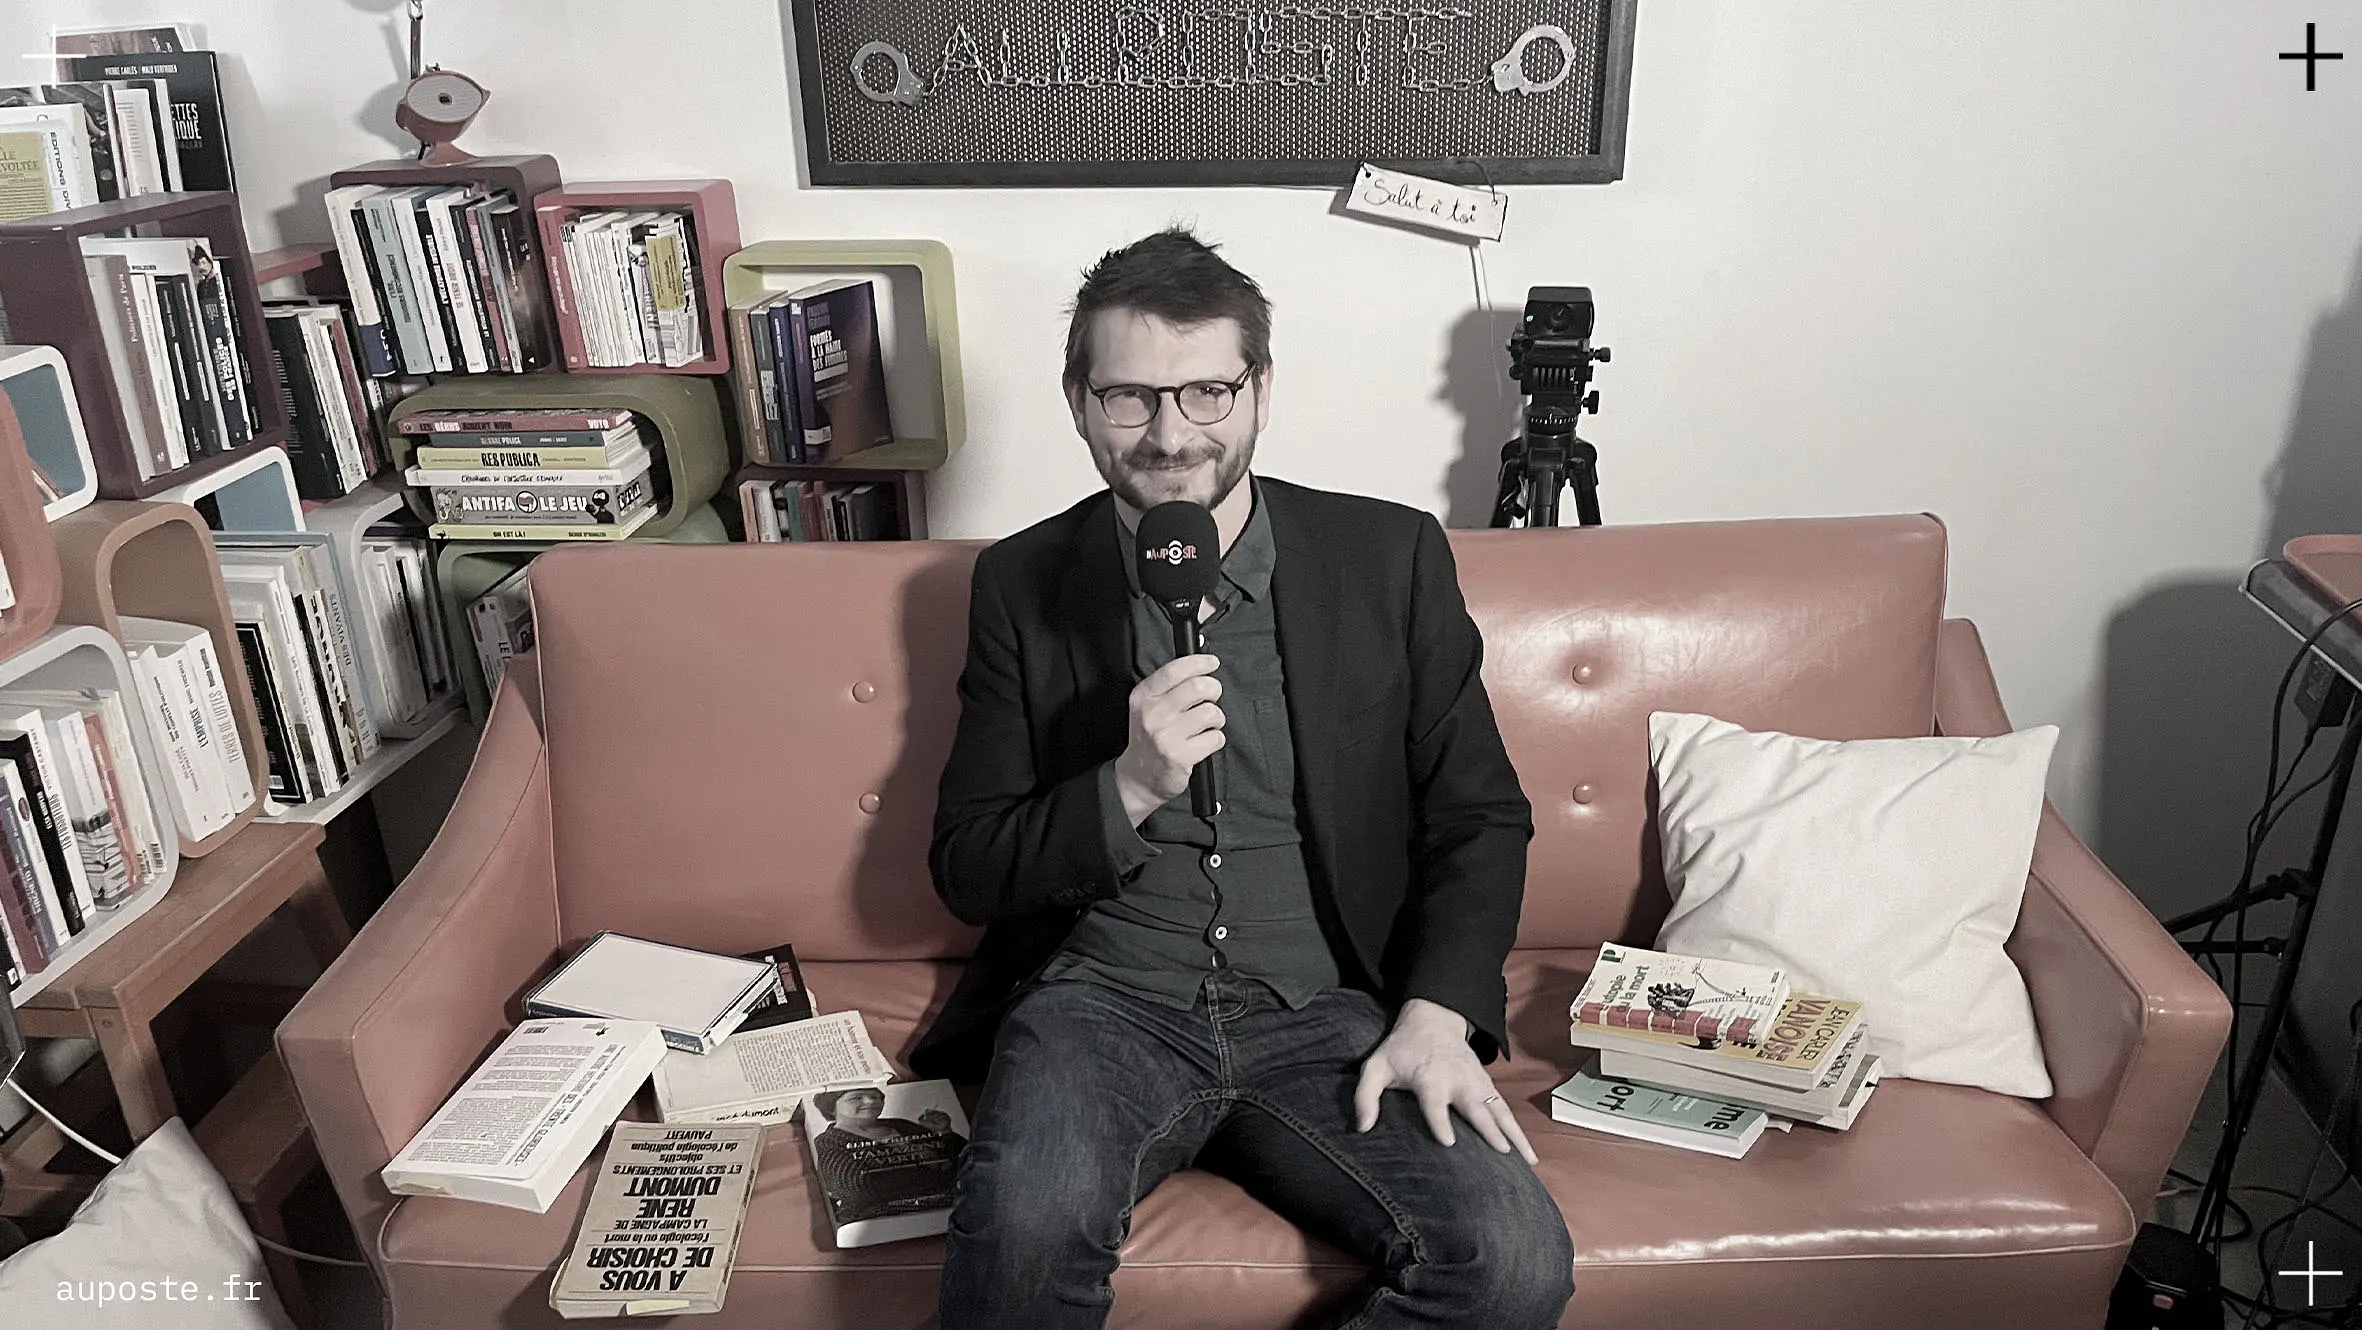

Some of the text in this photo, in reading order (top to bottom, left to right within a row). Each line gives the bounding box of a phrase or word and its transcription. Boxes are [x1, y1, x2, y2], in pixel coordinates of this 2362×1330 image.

[170, 103, 199, 121] ETTES
[174, 120, 202, 140] IQUE
[0, 160, 40, 172] VOLTÉE
[62, 190, 72, 210] DIV
[1364, 178, 1424, 211] Salut
[1447, 198, 1477, 224] toi
[481, 452, 541, 467] RES PUBLICA
[462, 497, 587, 511] ANTIFA LE JEU
[325, 593, 349, 643] VIVANTS
[1629, 965, 1650, 991] mort
[1597, 1086, 1635, 1111] ort
[1703, 1103, 1749, 1130] me
[664, 1130, 713, 1140] PAUVERT
[631, 1142, 673, 1153] politique
[659, 1153, 704, 1164] objectifs
[612, 1164, 743, 1176] ET SES PROLONGEMENTS
[623, 1176, 722, 1197] DUMONT
[613, 1219, 708, 1230] LA CAMPAGNE DE
[604, 1233, 631, 1243] mort
[632, 1233, 641, 1243] la
[643, 1233, 658, 1242] ou
[586, 1247, 716, 1268] DE CHOISIR
[599, 1270, 688, 1291] A VOUS
